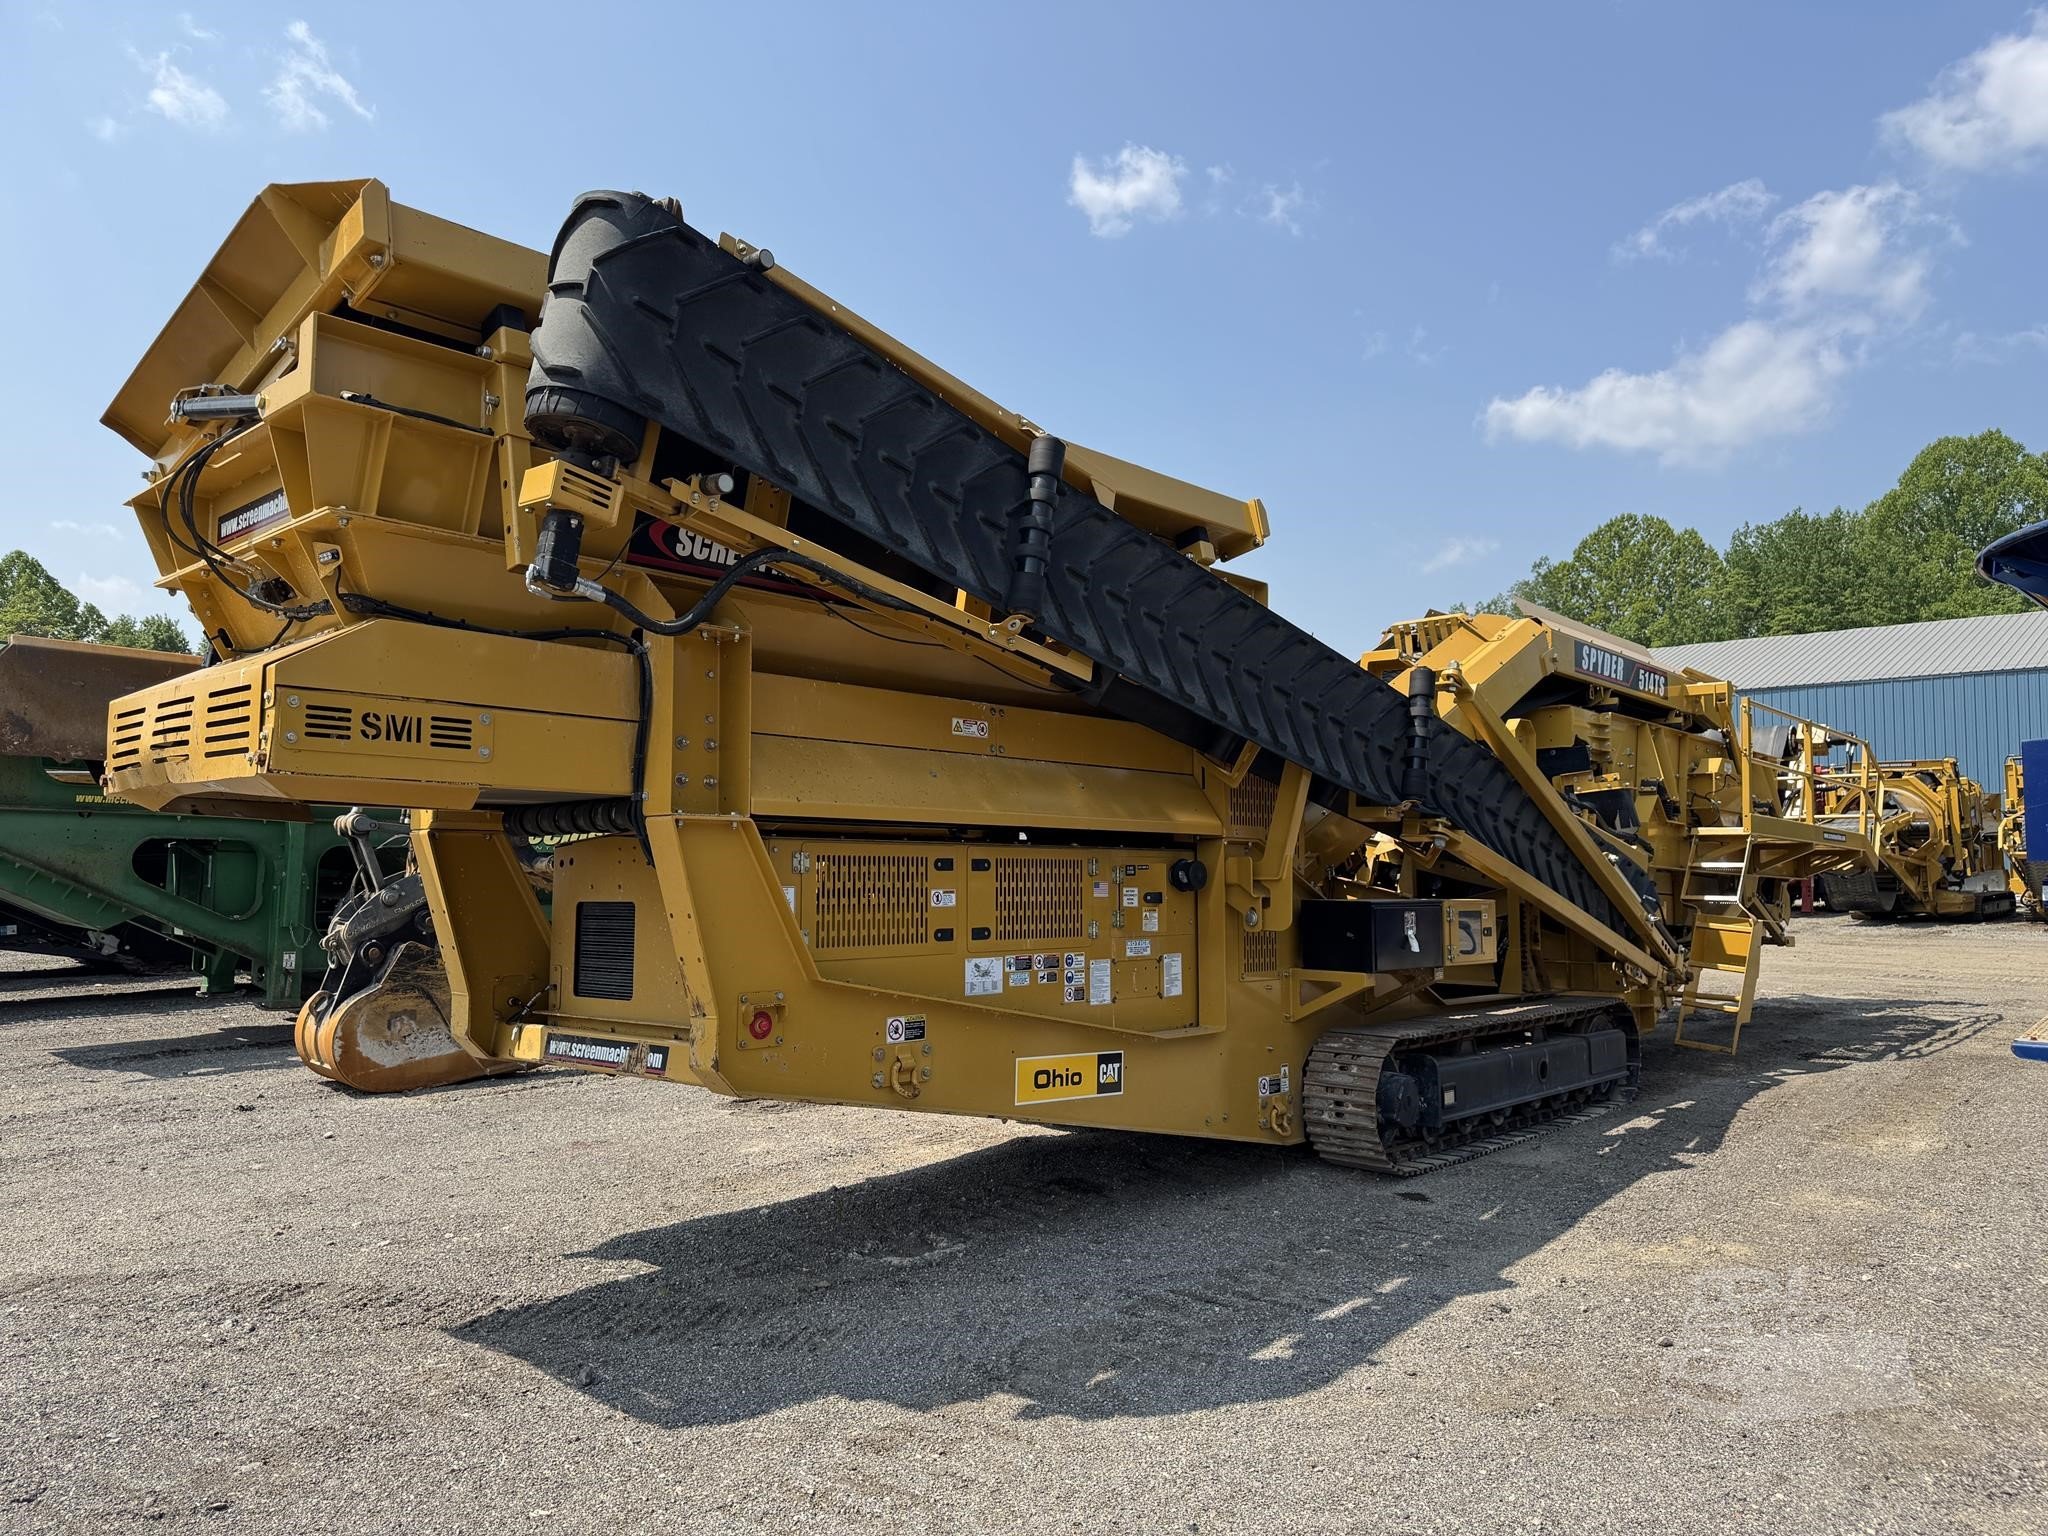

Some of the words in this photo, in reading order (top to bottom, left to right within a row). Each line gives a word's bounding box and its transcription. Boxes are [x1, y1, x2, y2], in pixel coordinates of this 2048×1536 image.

[1581, 644, 1624, 681] SPYDER
[1638, 668, 1665, 697] 514TS
[360, 712, 422, 743] SMI
[1033, 1067, 1083, 1090] Ohio
[1099, 1063, 1120, 1084] CAT
